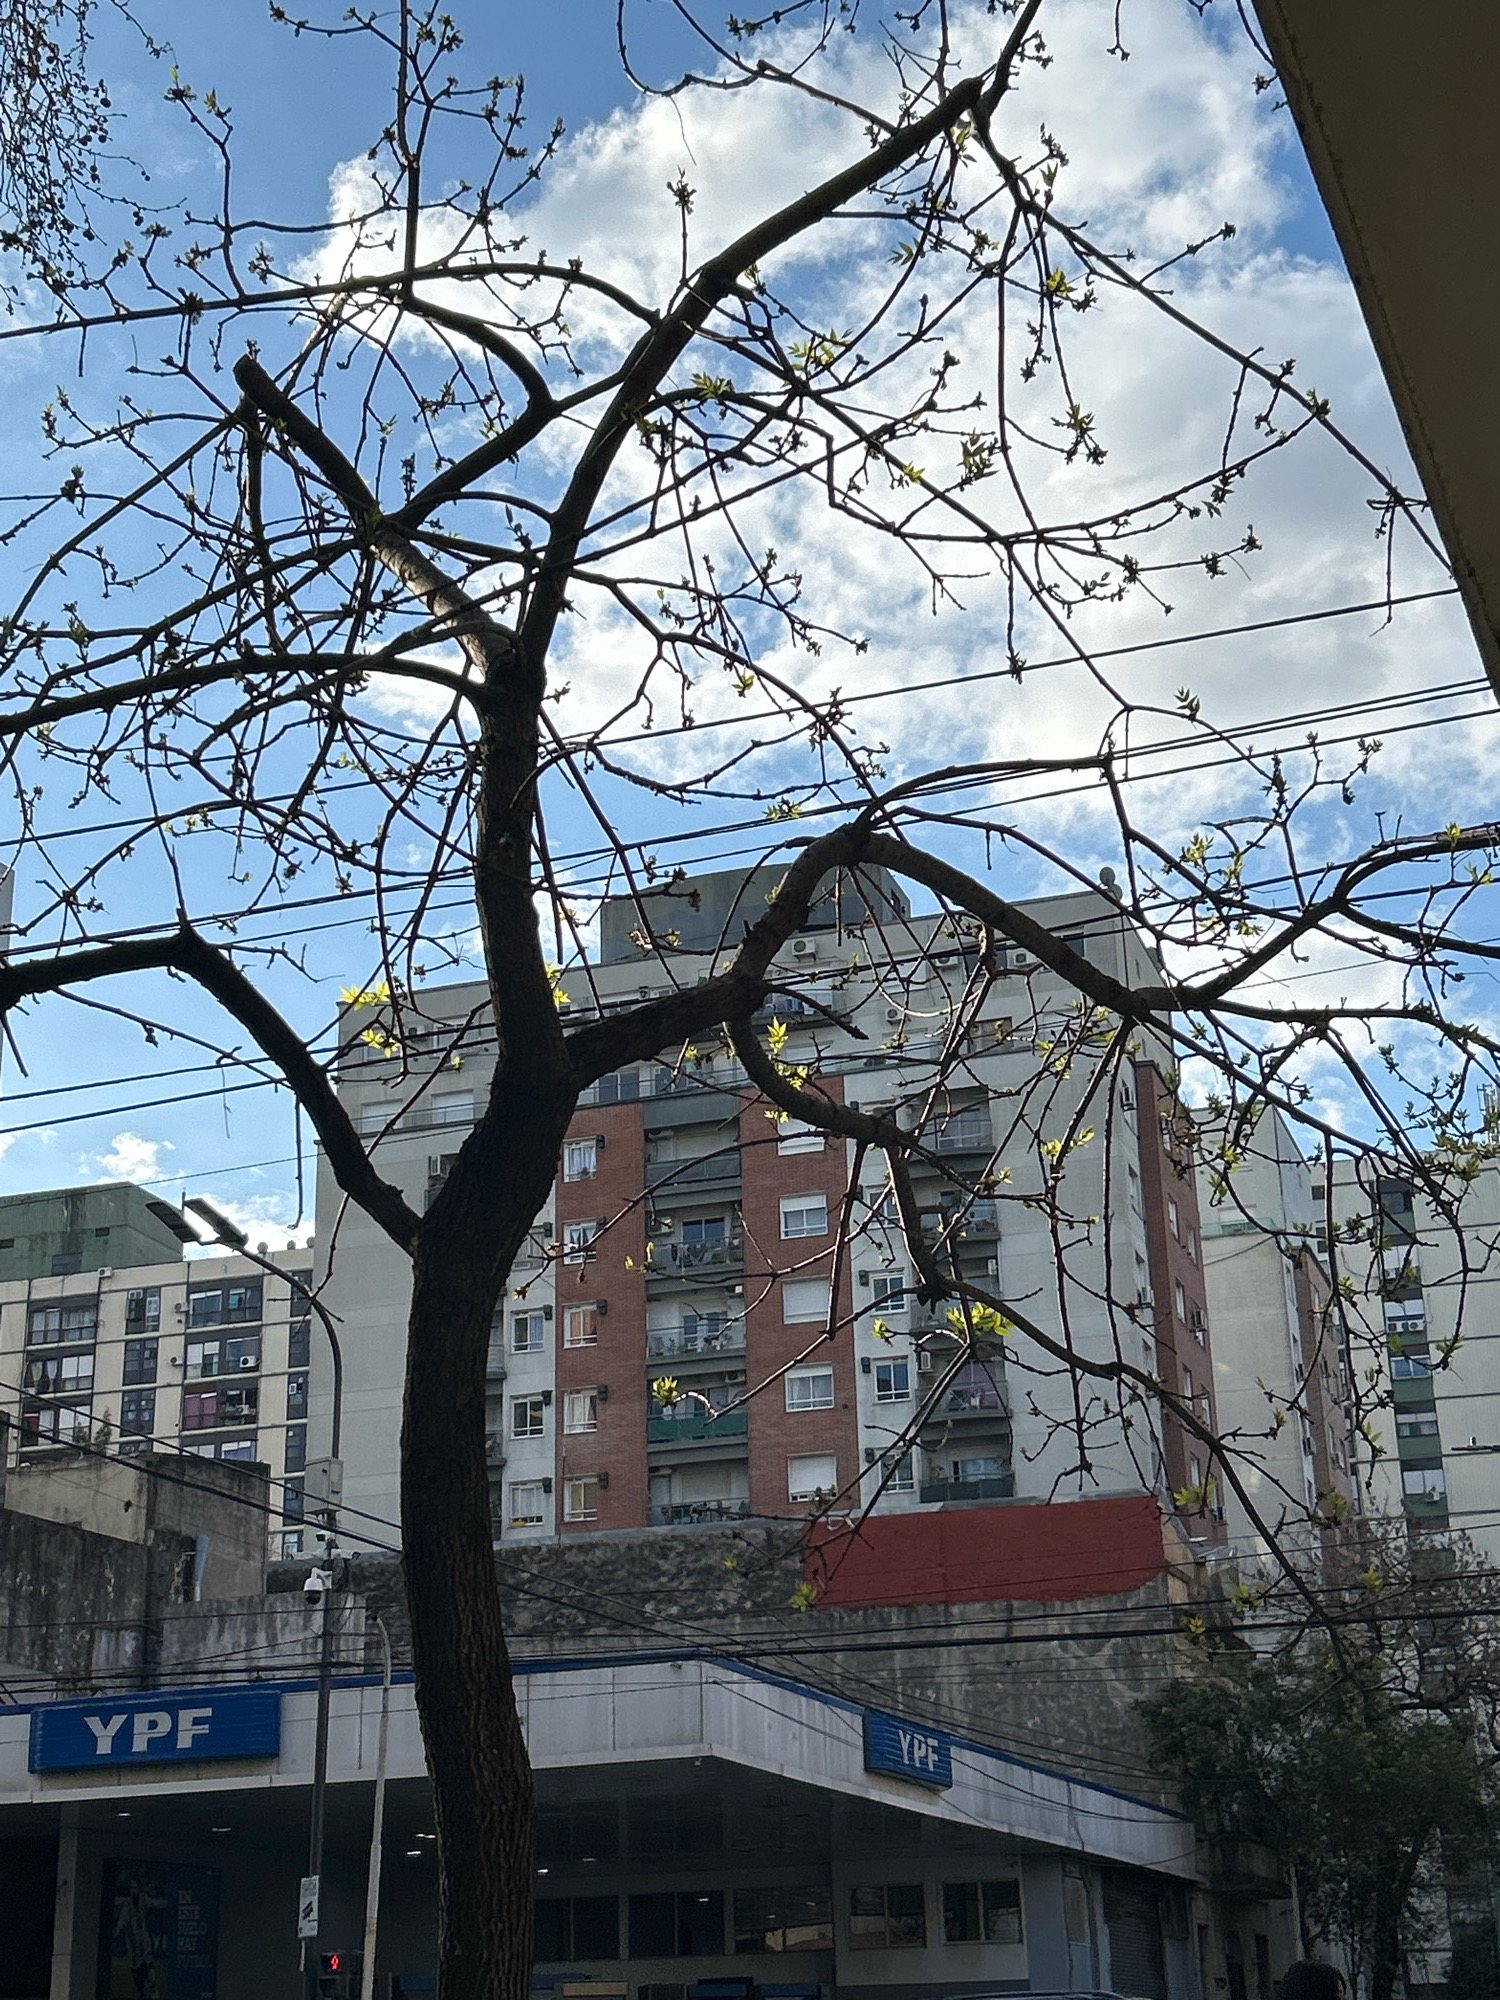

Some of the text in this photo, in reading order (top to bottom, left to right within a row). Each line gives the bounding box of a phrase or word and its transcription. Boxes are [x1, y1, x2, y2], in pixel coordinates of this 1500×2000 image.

[83, 1707, 213, 1755] YPF
[898, 1729, 939, 1772] YPF
[177, 1921, 207, 1935] SUELO
